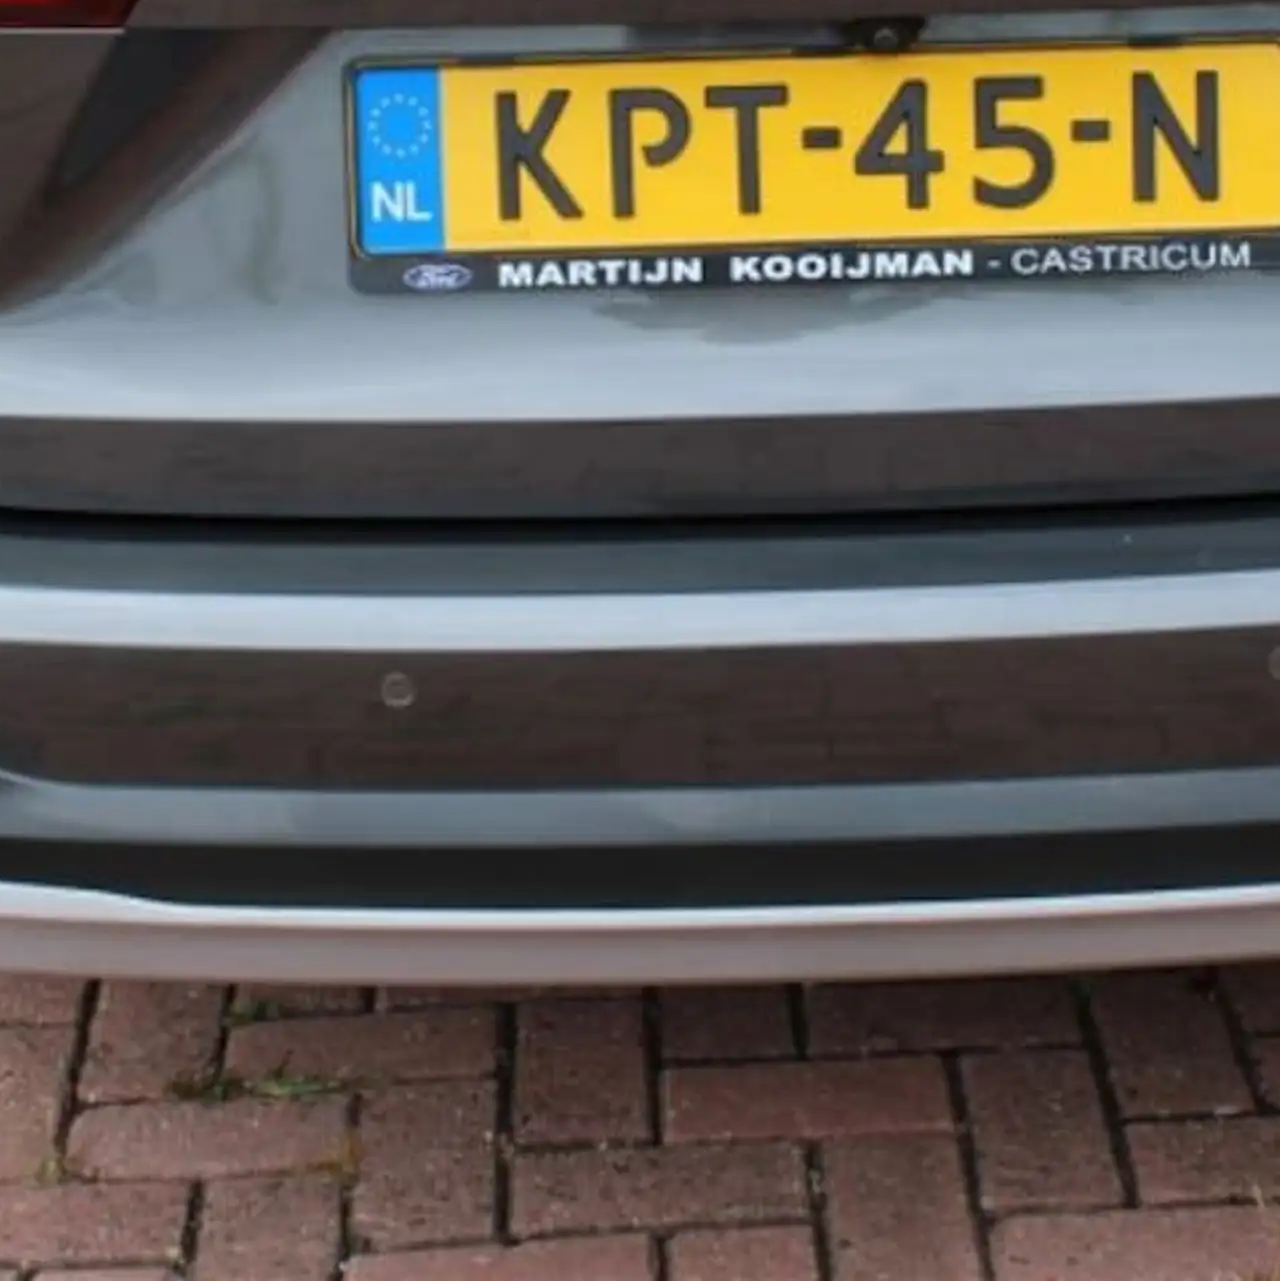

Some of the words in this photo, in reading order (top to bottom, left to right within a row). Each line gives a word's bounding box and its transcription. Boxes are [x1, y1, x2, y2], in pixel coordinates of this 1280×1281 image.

[494, 69, 1220, 221] KPT-45-N
[369, 181, 433, 223] NL
[498, 257, 704, 288] MARTIJN
[730, 249, 974, 282] KOOIJMAN
[1009, 241, 1252, 273] CASTRICUM
